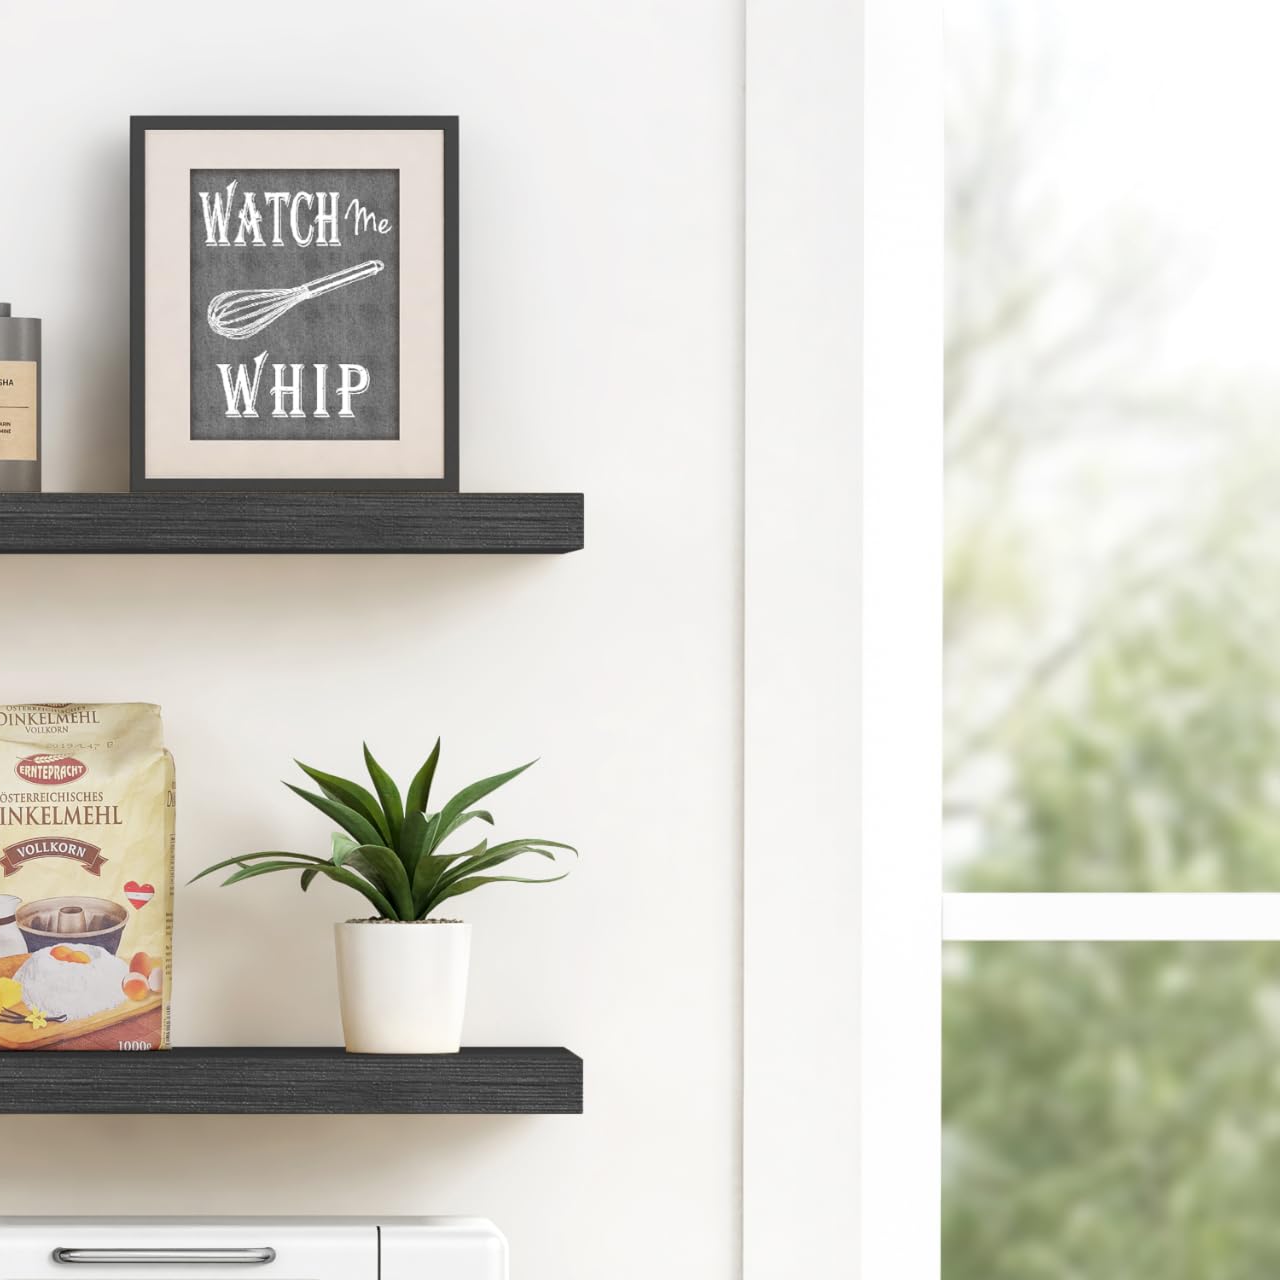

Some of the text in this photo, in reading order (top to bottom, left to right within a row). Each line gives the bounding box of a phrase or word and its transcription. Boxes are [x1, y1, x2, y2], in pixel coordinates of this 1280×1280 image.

[198, 178, 392, 247] WATCH Me
[216, 350, 370, 418] WHIP
[25, 726, 69, 734] VOLLKORN
[19, 764, 84, 780] ERNTEPRACHT
[0, 791, 104, 803] ÖSTERREICHISCHES
[17, 842, 87, 858] VOLLKORN
